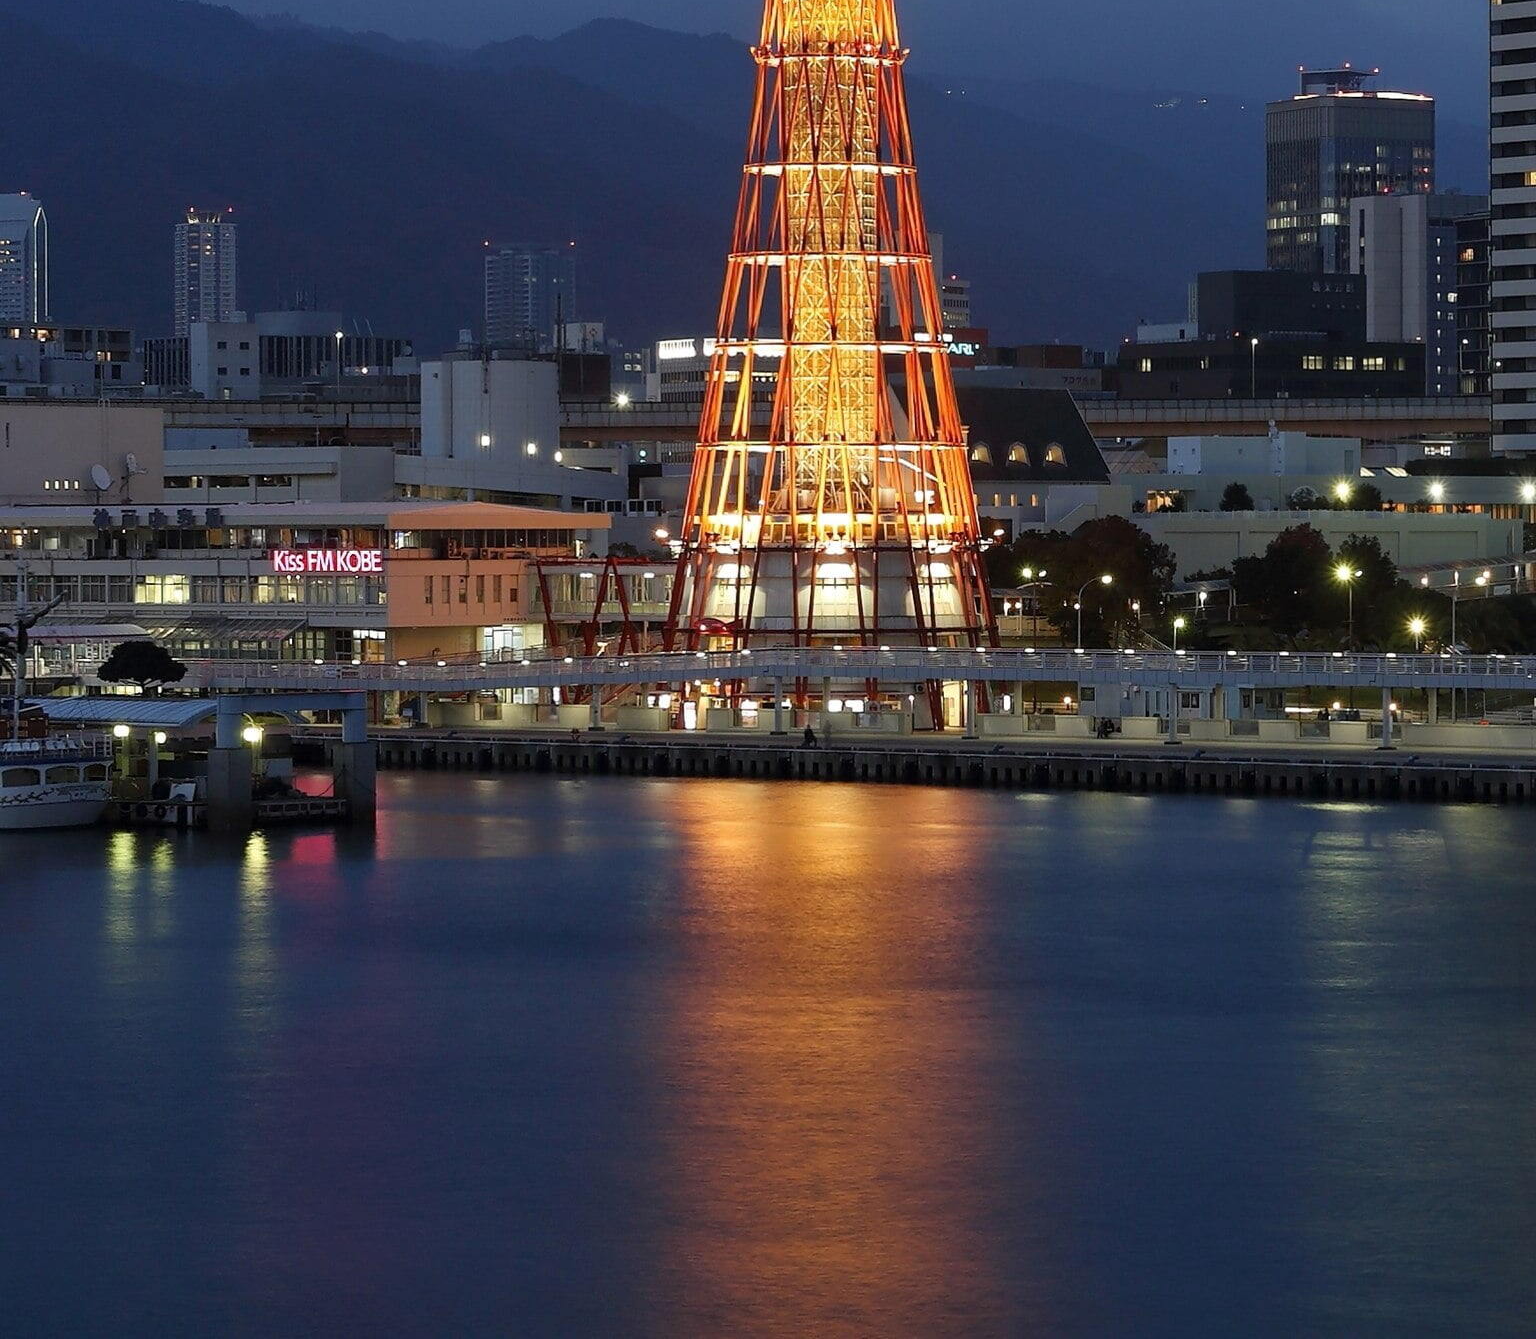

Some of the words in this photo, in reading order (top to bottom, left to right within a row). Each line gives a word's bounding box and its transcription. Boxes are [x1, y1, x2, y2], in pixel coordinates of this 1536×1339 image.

[274, 550, 305, 572] Kiss
[307, 550, 335, 571] FM
[336, 550, 382, 572] KOBE
